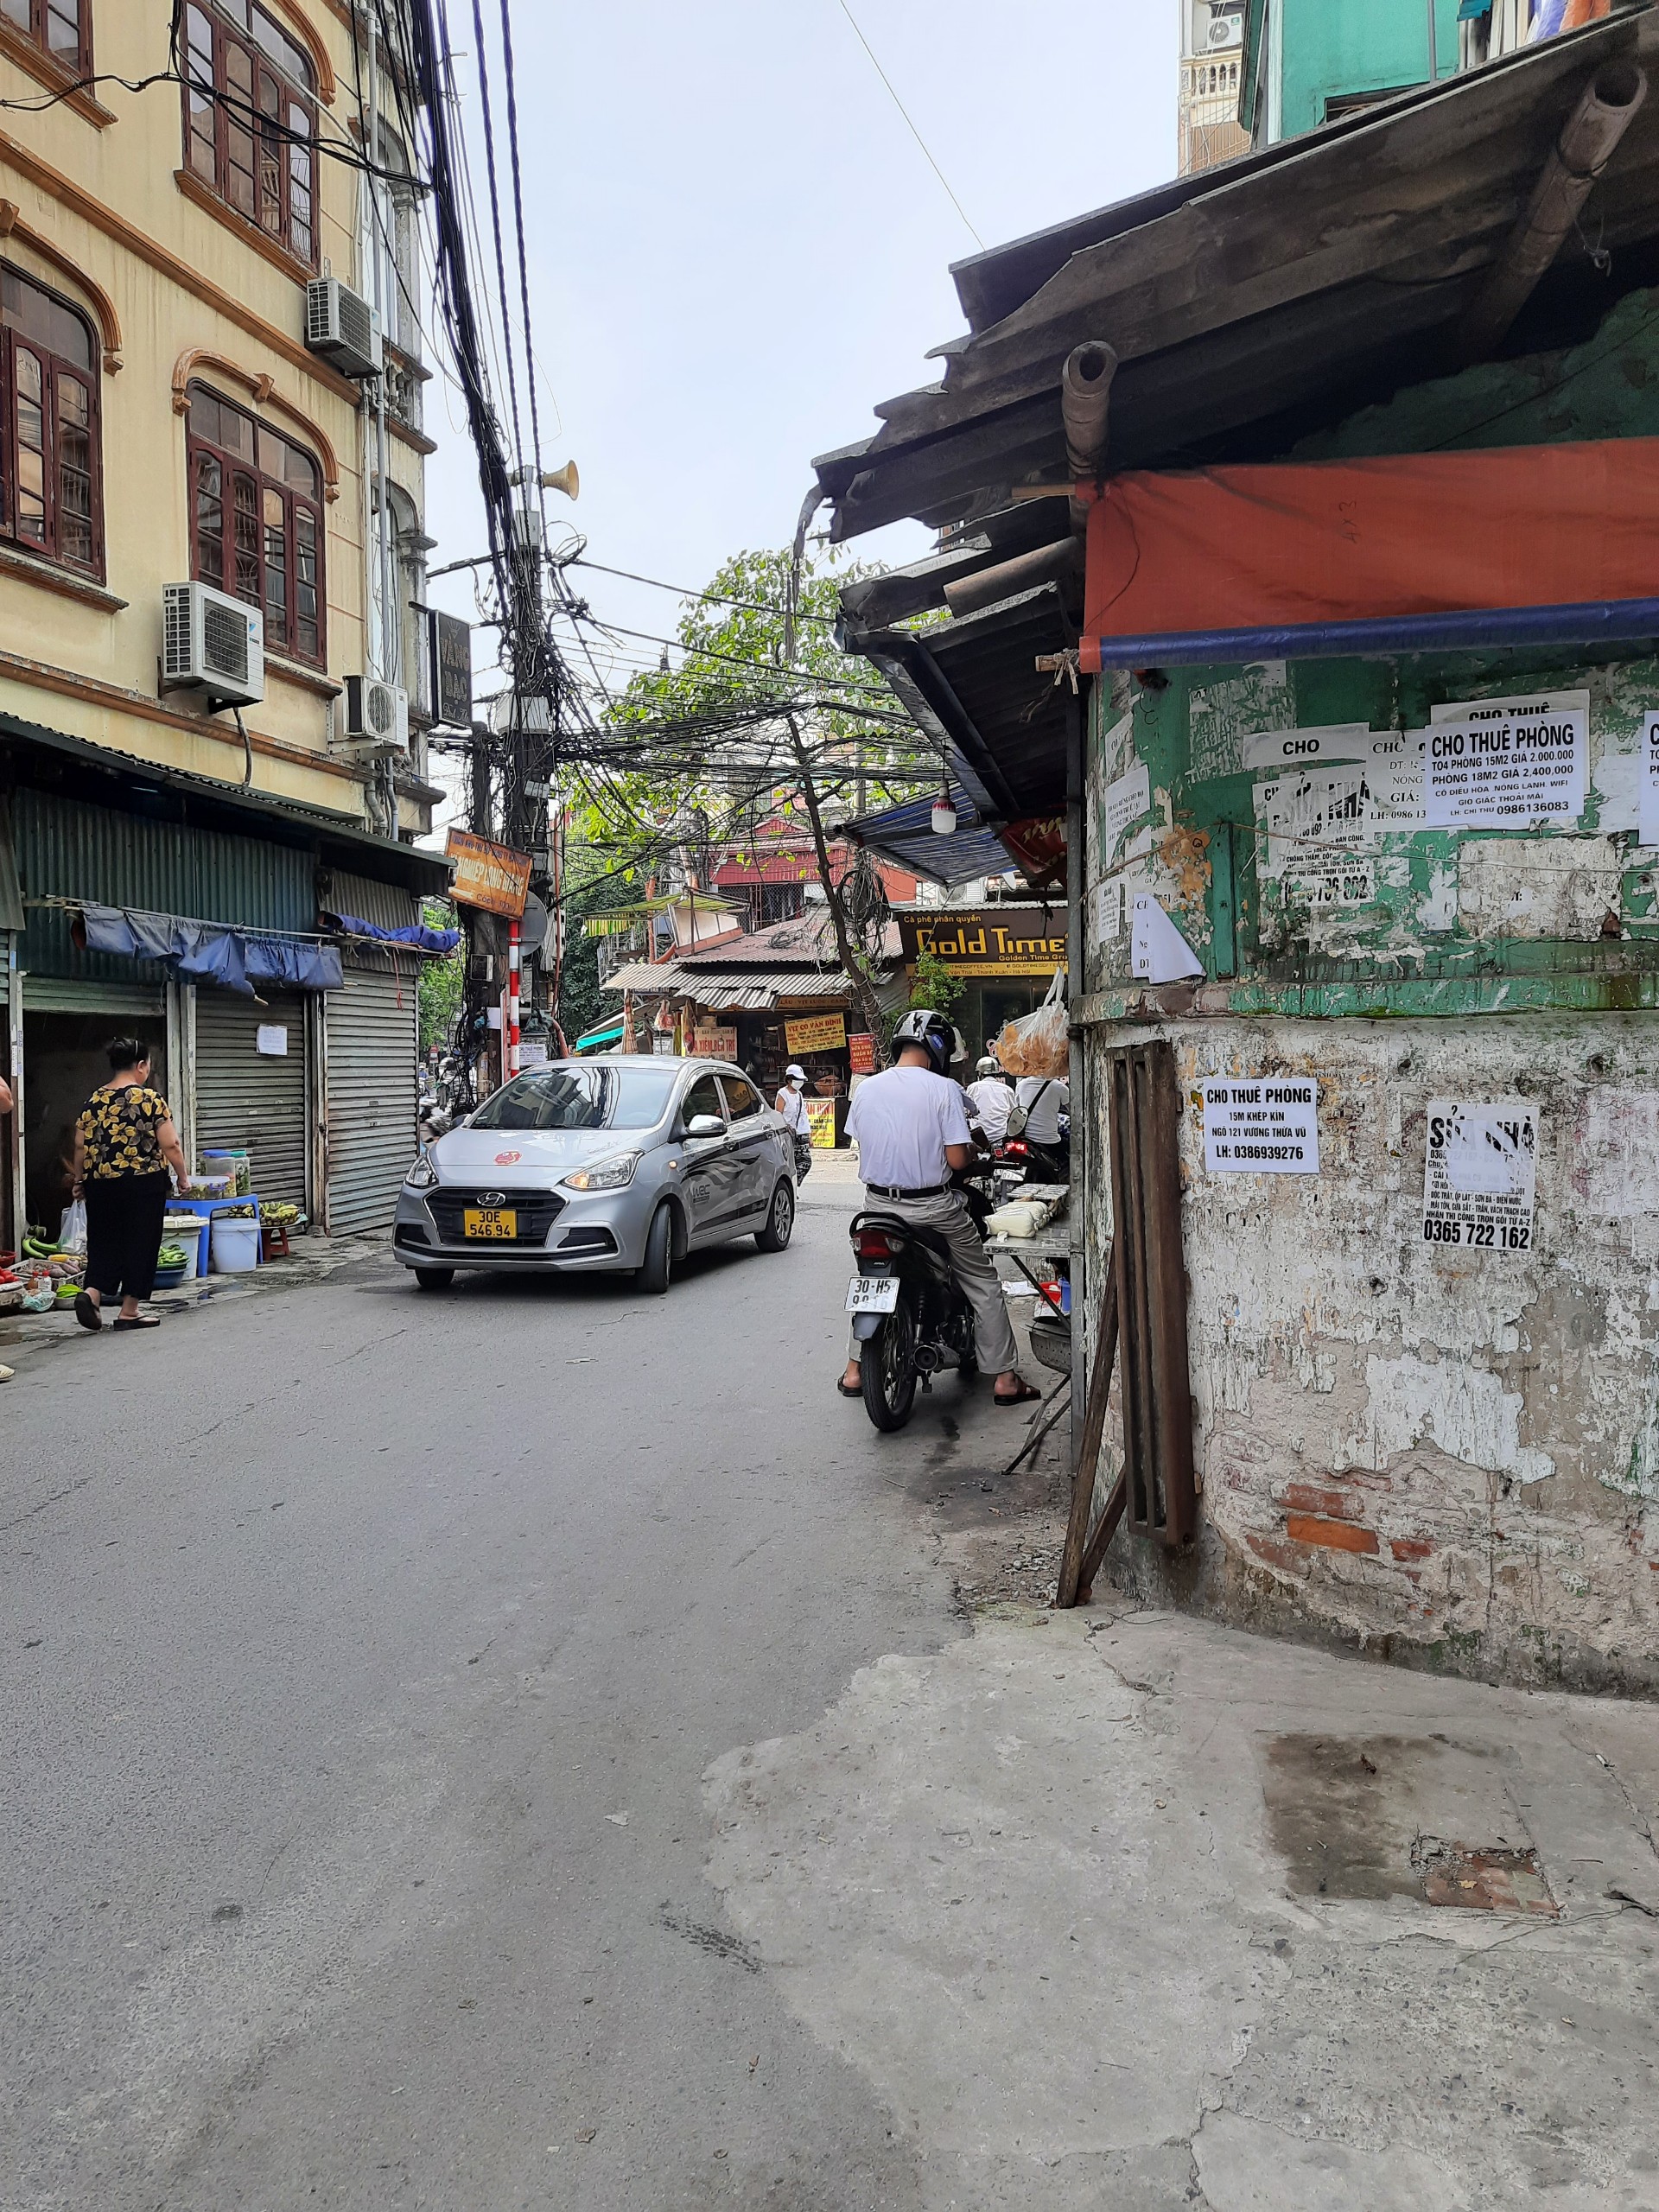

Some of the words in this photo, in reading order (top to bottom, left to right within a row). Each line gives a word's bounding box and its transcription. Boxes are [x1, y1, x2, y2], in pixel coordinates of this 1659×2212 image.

[1432, 734, 1465, 757] CHO
[1469, 724, 1511, 753] THUÊ
[1516, 721, 1574, 749] PHÒNG
[1282, 739, 1320, 755] CHO
[1452, 756, 1483, 769] PHÒNG
[1485, 754, 1509, 766] 15M2
[1511, 751, 1528, 764] GIÁ
[1530, 749, 1574, 762] 2.000.000
[1432, 772, 1468, 785] PHÒNG
[1471, 771, 1498, 782] 18M2
[1502, 766, 1520, 779] GIÁ
[1522, 765, 1573, 778] 2,400,000
[1390, 790, 1420, 803] GIÁ:
[1435, 788, 1447, 797] CÓ
[1370, 811, 1389, 820] LH:
[1390, 810, 1414, 819] 0986
[1497, 801, 1569, 815] 0986136083
[917, 914, 931, 925] phê
[916, 927, 988, 956] Gold
[1207, 1089, 1228, 1103] CHO
[1231, 1086, 1262, 1103] THUÊ
[1266, 1084, 1312, 1103] PHÒNG
[1229, 1111, 1245, 1122] 15M
[1247, 1109, 1268, 1122] KHÉP
[1270, 1109, 1285, 1122] KÍN
[1212, 1126, 1227, 1137] NGÕ
[1229, 1128, 1241, 1137] 121
[1243, 1127, 1270, 1138] VƯƠNG
[1272, 1126, 1293, 1138] THỪA
[1295, 1126, 1306, 1138] VŨ
[1217, 1145, 1231, 1158] LH:
[1235, 1146, 1304, 1160] 0386939276
[479, 1211, 500, 1223] 30E
[1458, 1211, 1475, 1221] CÔNG
[1496, 1214, 1507, 1224] GÓI
[1519, 1218, 1531, 1227] A-Z
[470, 1224, 511, 1236] 546.94
[1424, 1219, 1461, 1243] 0365
[1466, 1224, 1495, 1247] 722
[1500, 1226, 1529, 1249] 162
